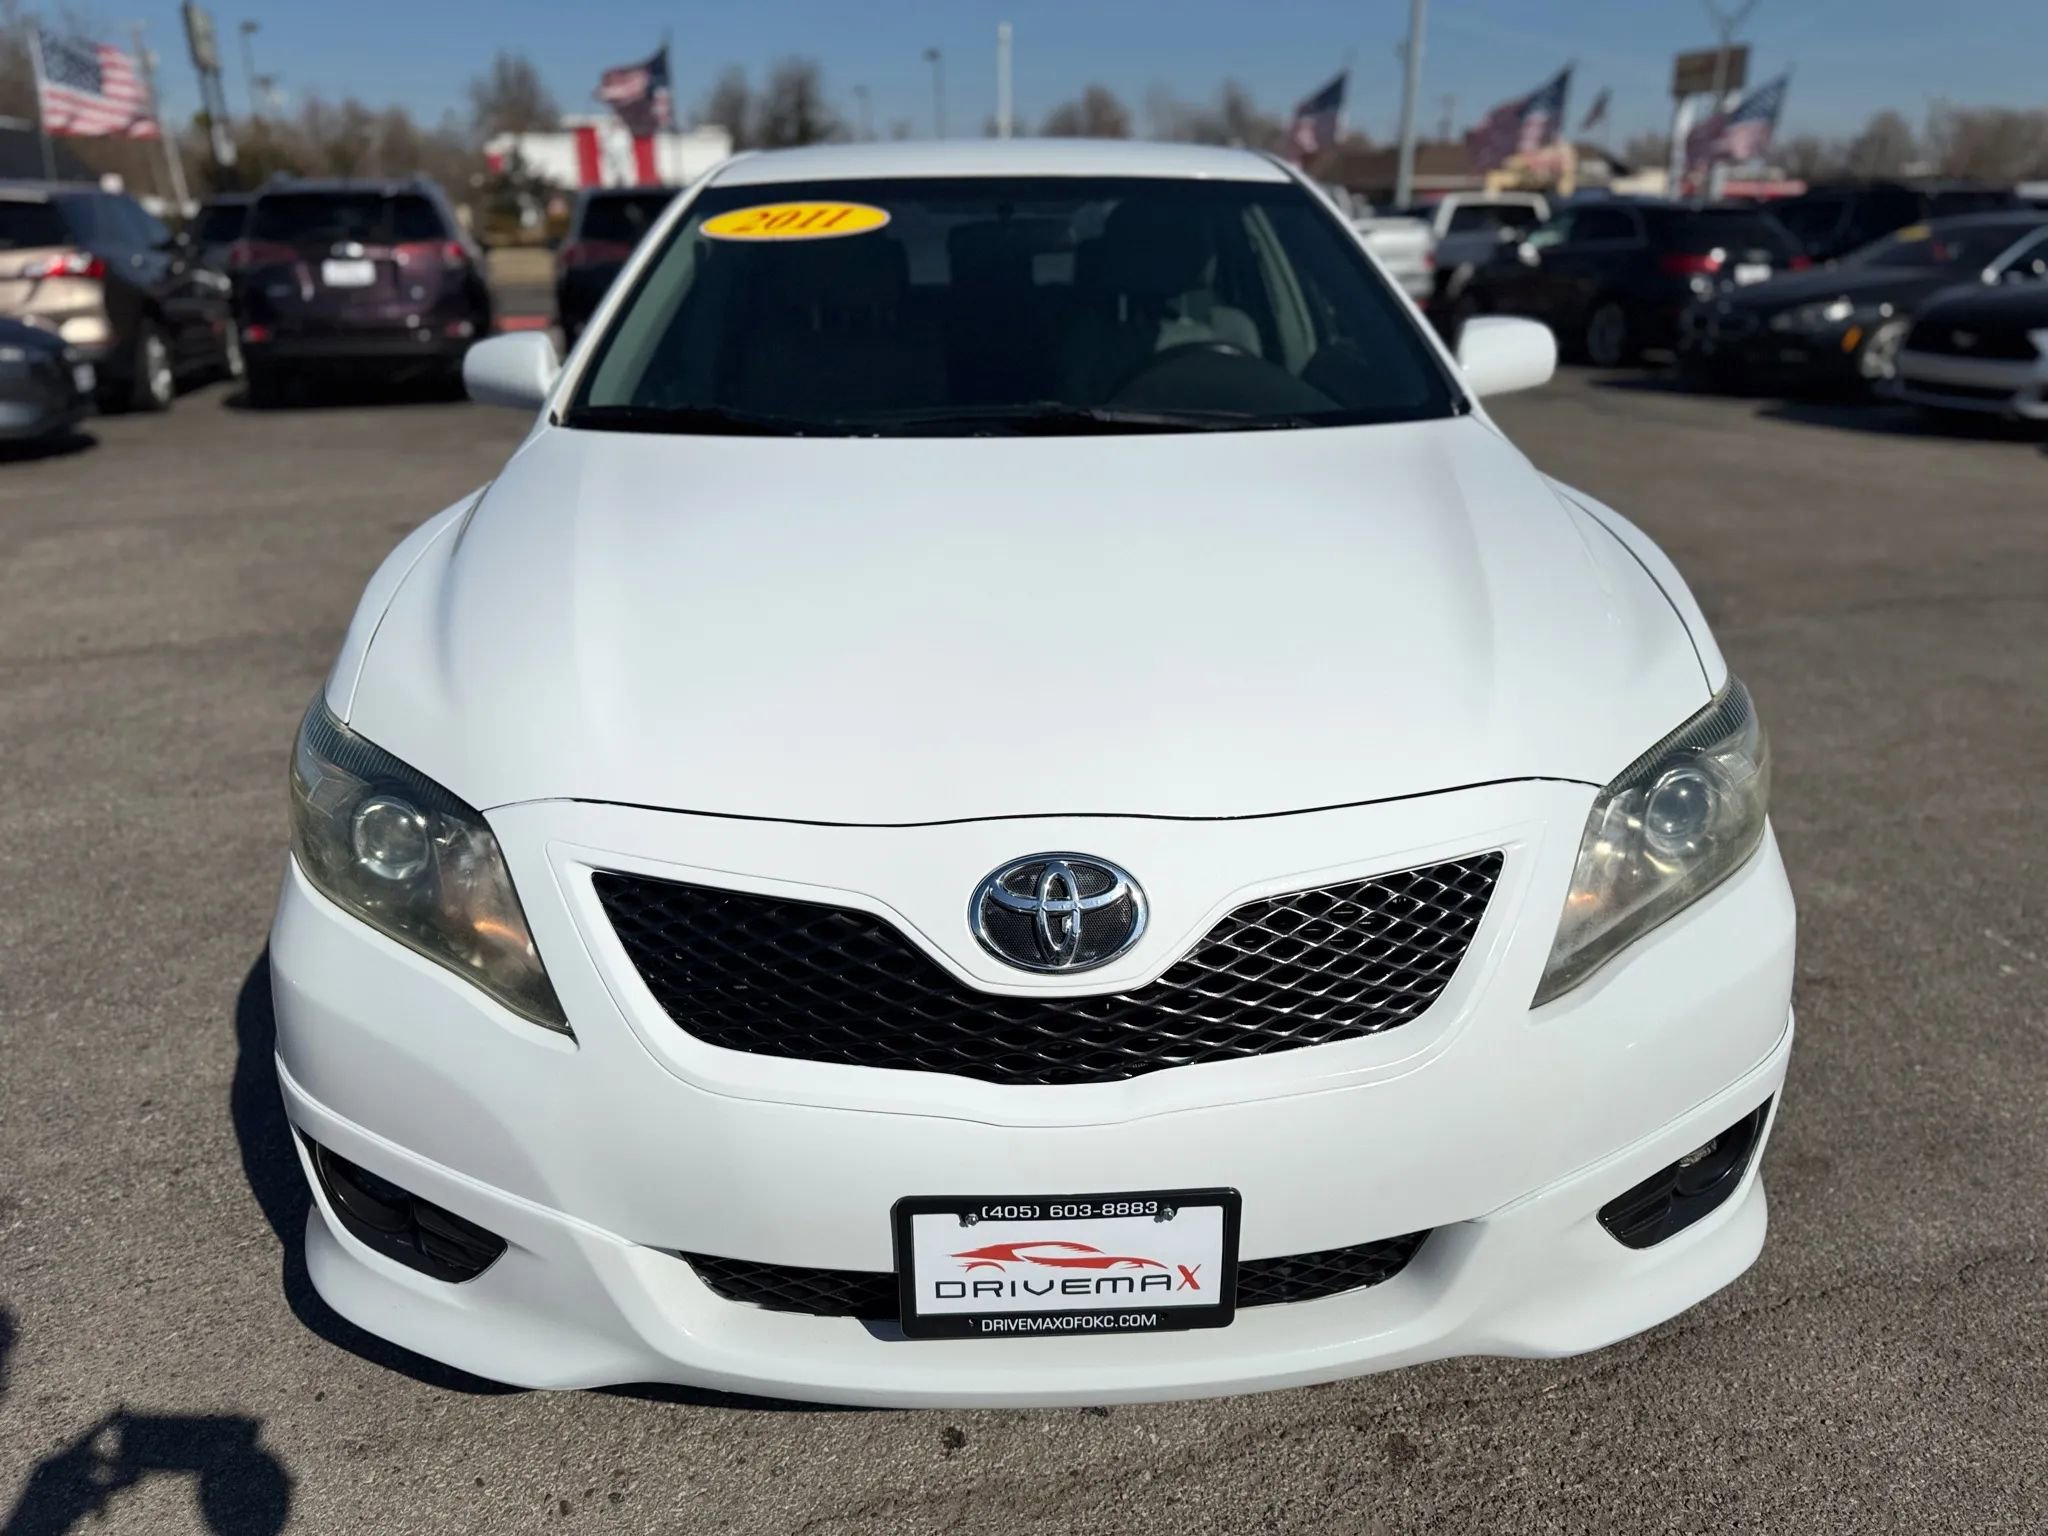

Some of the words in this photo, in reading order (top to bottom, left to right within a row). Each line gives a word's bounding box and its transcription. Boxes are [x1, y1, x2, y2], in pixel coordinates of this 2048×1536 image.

[730, 207, 856, 234] 2011
[981, 1204, 1041, 1219] (405)
[1049, 1201, 1159, 1218] 603-8883
[935, 1263, 1203, 1299] DRIVEMAX
[981, 1314, 1157, 1333] DRIVEMAXOFOKC.COM
